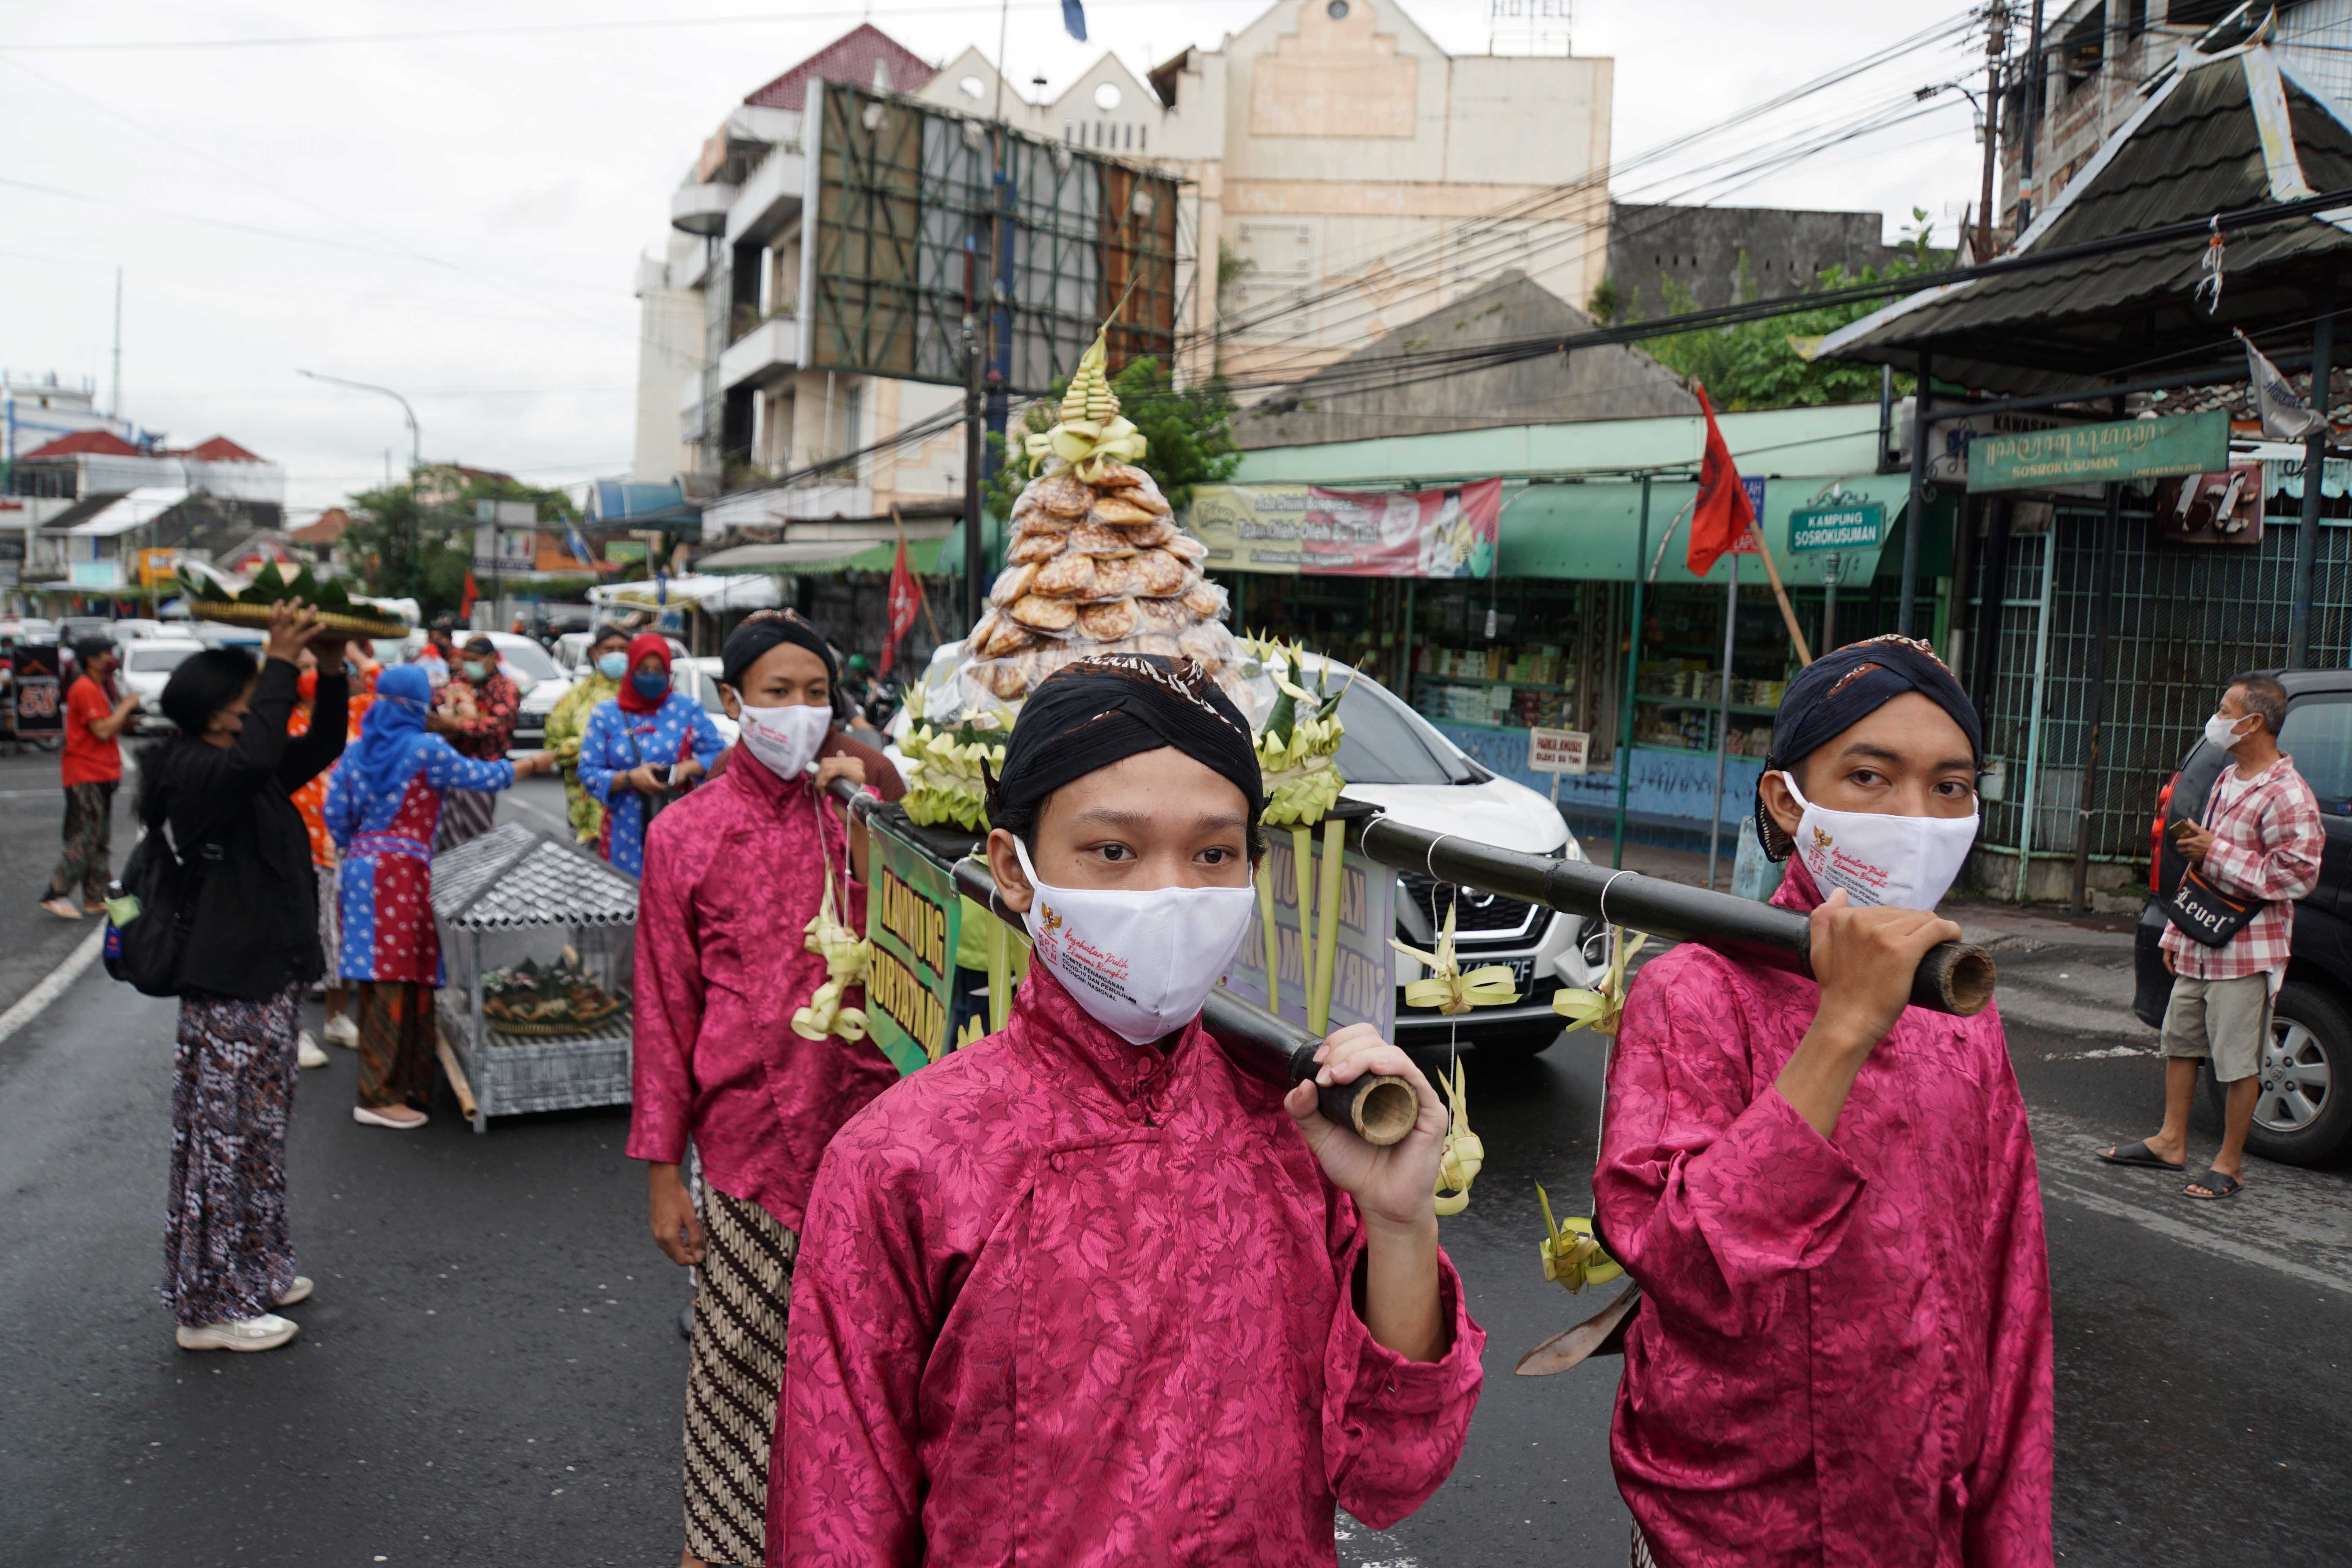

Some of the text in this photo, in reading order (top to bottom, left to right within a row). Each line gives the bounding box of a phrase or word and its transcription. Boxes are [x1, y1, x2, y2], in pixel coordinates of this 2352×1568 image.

[2012, 457, 2118, 479] SOSROKUSUMAN
[1808, 512, 1863, 528] KAMPUNG
[1795, 526, 1876, 547] SOSROKUSUMAN
[1537, 737, 1583, 753] PARKIR KHUSUS
[1831, 846, 1889, 878] Kesehatan Pulih
[1833, 859, 1888, 888] Ekonomi Bangkit
[1826, 870, 1846, 885] COVID-19
[1847, 884, 1858, 892] DAN
[1827, 865, 1880, 898] KOMITE PENANGANAN
[1064, 928, 1129, 969] Kesehatan Pulih
[1066, 945, 1129, 981] Ekonomi Bangkit
[1062, 952, 1125, 992] KOMITE PENANGANAN
[1062, 958, 1137, 1004] COVID-19 DAN PEMULIHAN
[1062, 964, 1116, 1002] EKONOMI NASIONAL
